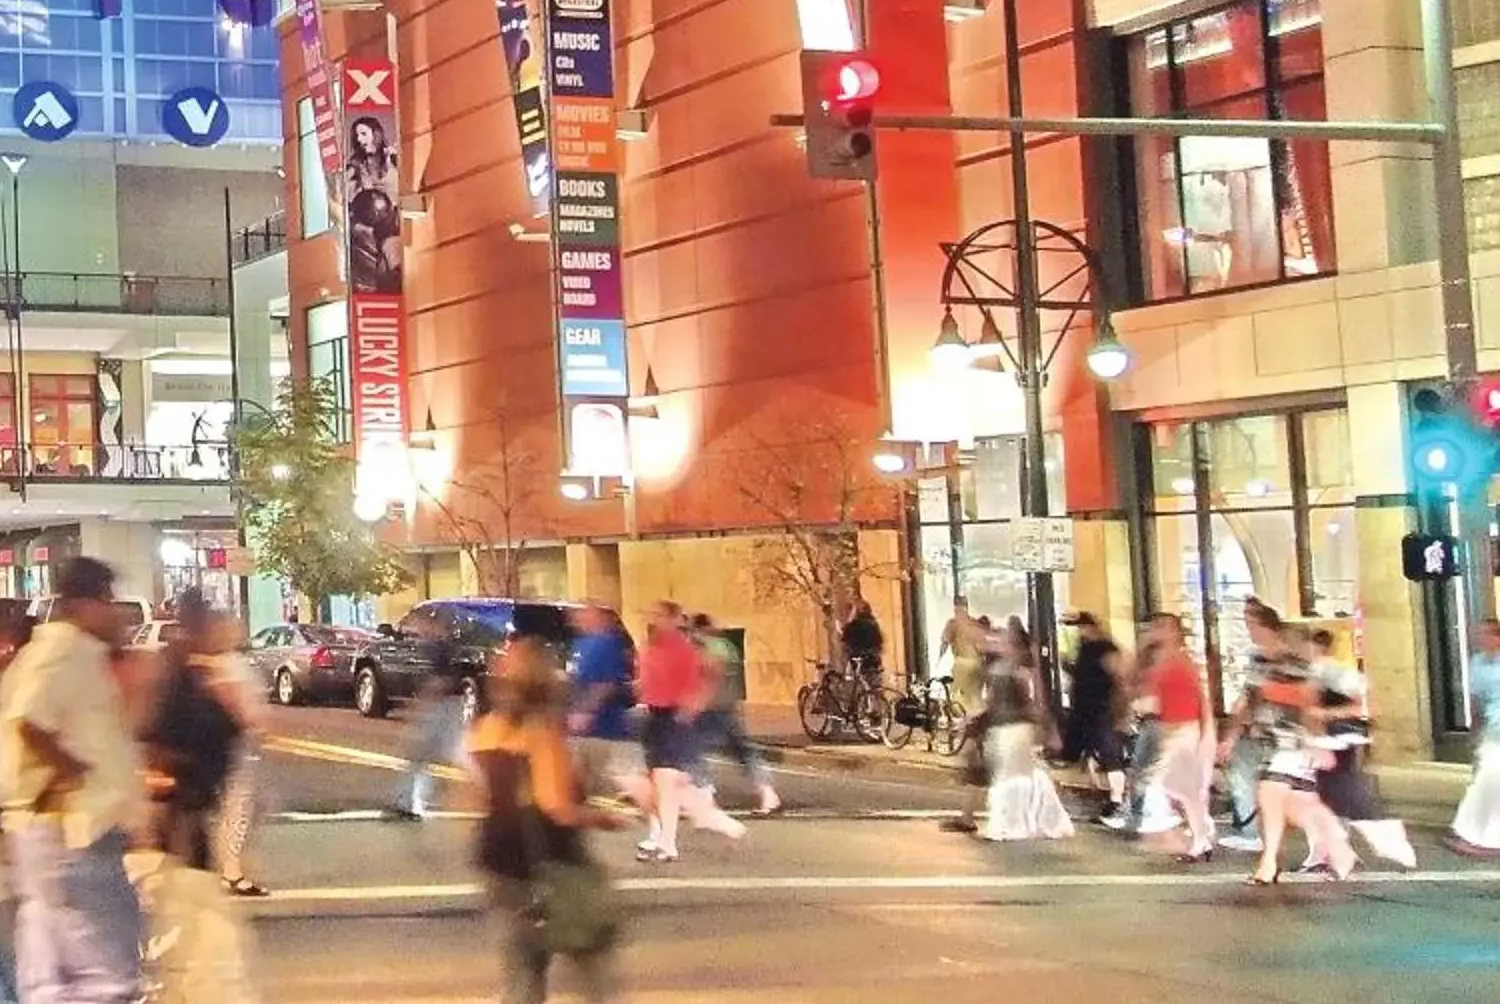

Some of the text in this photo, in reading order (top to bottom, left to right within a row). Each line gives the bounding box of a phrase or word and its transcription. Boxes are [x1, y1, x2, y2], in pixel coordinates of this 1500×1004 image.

[553, 31, 600, 51] MUSIC
[346, 69, 391, 104] X
[556, 73, 584, 87] VINYL
[556, 104, 611, 124] MOVIES
[560, 179, 606, 198] BOOKS
[561, 251, 612, 270] GAMES
[562, 276, 592, 289] VIDEO
[356, 301, 400, 378] LUCKY
[565, 327, 602, 345] GEAR
